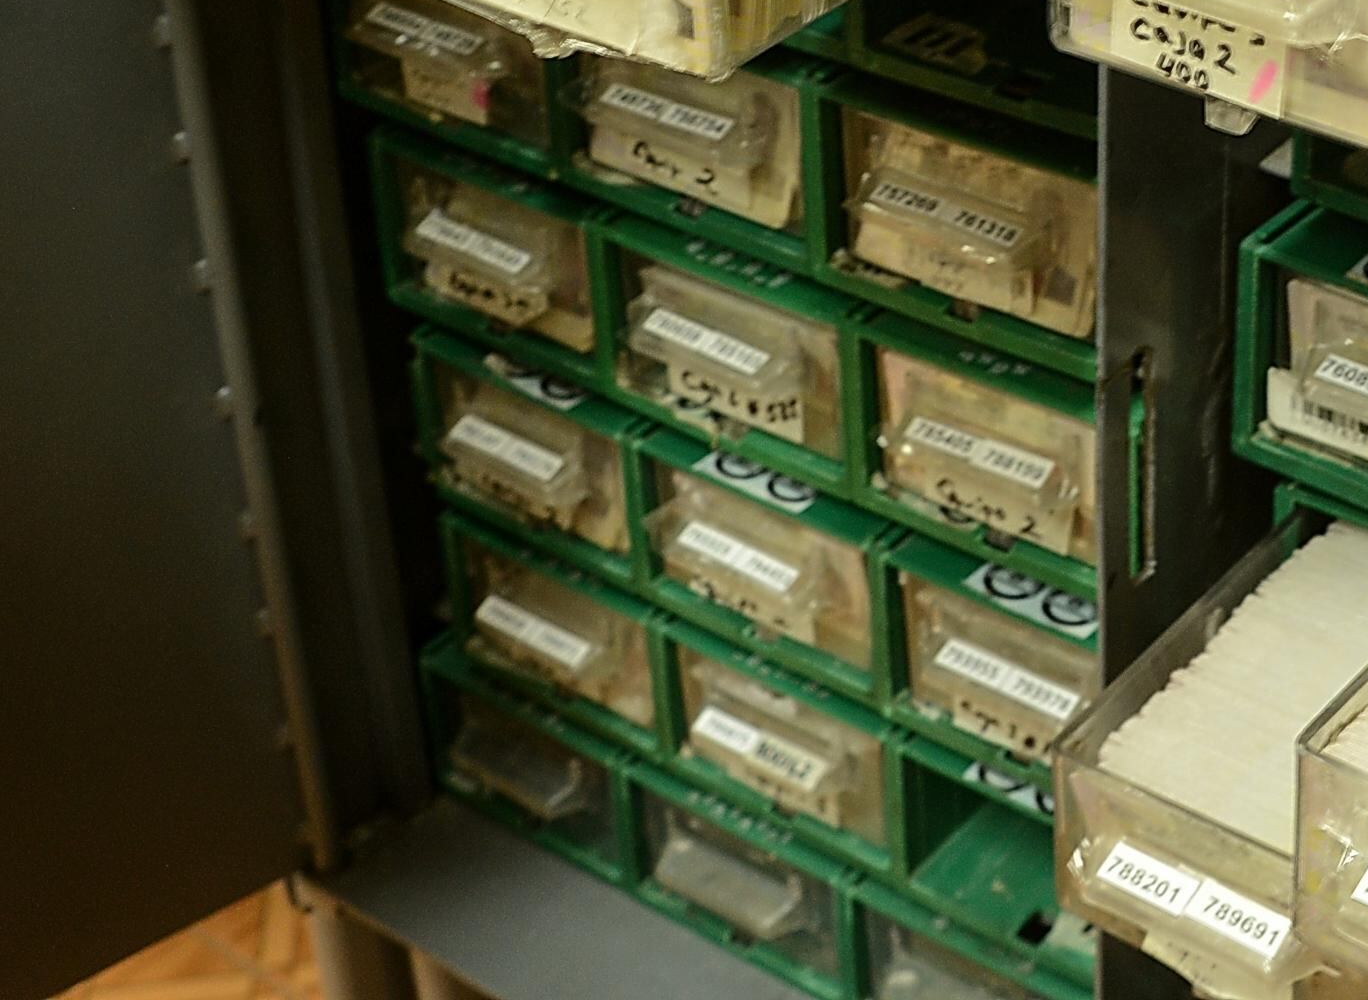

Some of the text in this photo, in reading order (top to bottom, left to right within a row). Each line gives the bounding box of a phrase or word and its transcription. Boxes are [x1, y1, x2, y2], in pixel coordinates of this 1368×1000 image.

[1212, 43, 1239, 77] 2
[1104, 855, 1283, 948] 788201 789691
